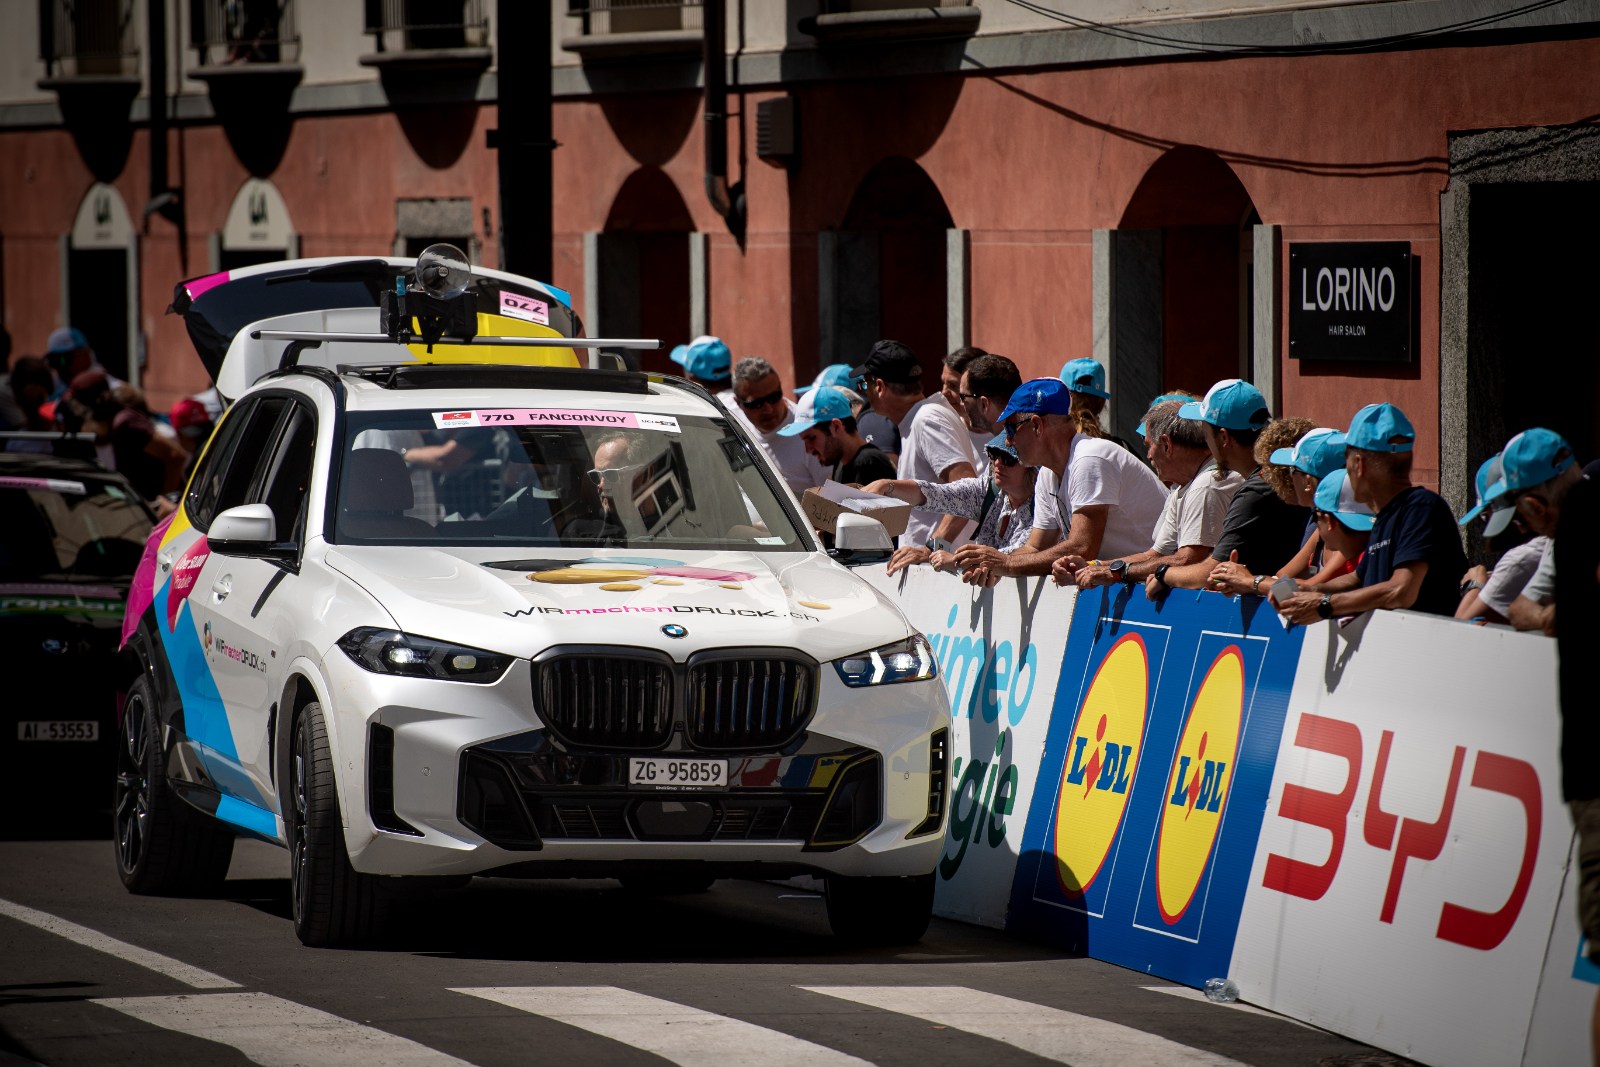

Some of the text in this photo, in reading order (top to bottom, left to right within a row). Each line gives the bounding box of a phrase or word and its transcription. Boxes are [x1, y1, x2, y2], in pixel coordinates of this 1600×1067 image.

[1302, 266, 1395, 312] LORINO
[504, 298, 545, 315] 770
[1328, 325, 1366, 336] HAIR SALON
[482, 414, 515, 422] 770
[529, 413, 627, 424] FANCONVOY
[502, 605, 821, 622] WIRmachenDRUCK.ch
[940, 730, 1018, 882] gie
[1262, 711, 1543, 951] BYD
